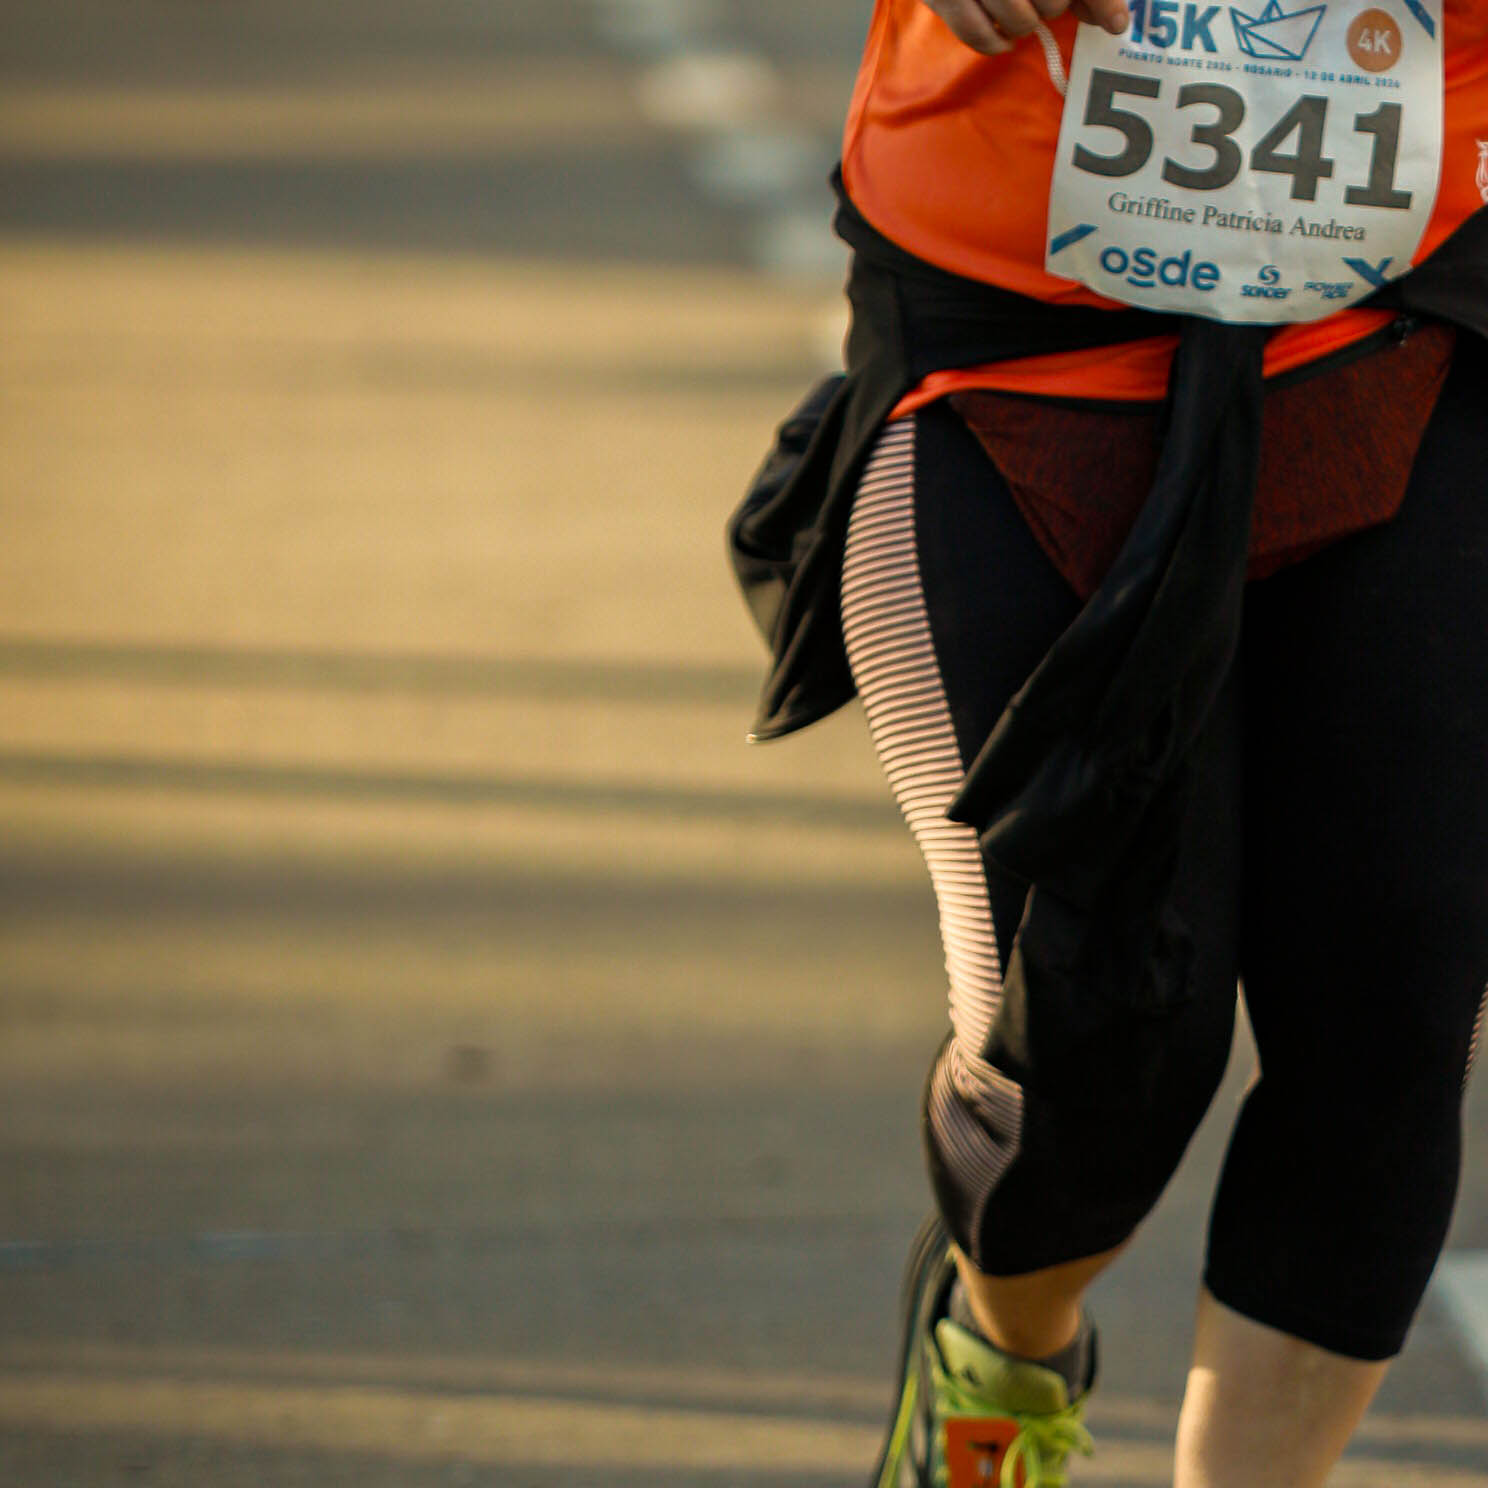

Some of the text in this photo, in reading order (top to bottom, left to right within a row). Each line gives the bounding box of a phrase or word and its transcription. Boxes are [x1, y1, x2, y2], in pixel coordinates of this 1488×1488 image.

[1357, 26, 1393, 57] 4K
[1119, 47, 1163, 64] PUERTO
[1167, 55, 1203, 69] NORTE
[1243, 63, 1292, 78] ROSARIO
[1320, 71, 1335, 82] DE
[1339, 73, 1371, 86] ABRIL
[1071, 67, 1414, 211] 5341
[1108, 191, 1367, 242] Griffine Patricia Andrea
[1100, 245, 1221, 292] osde
